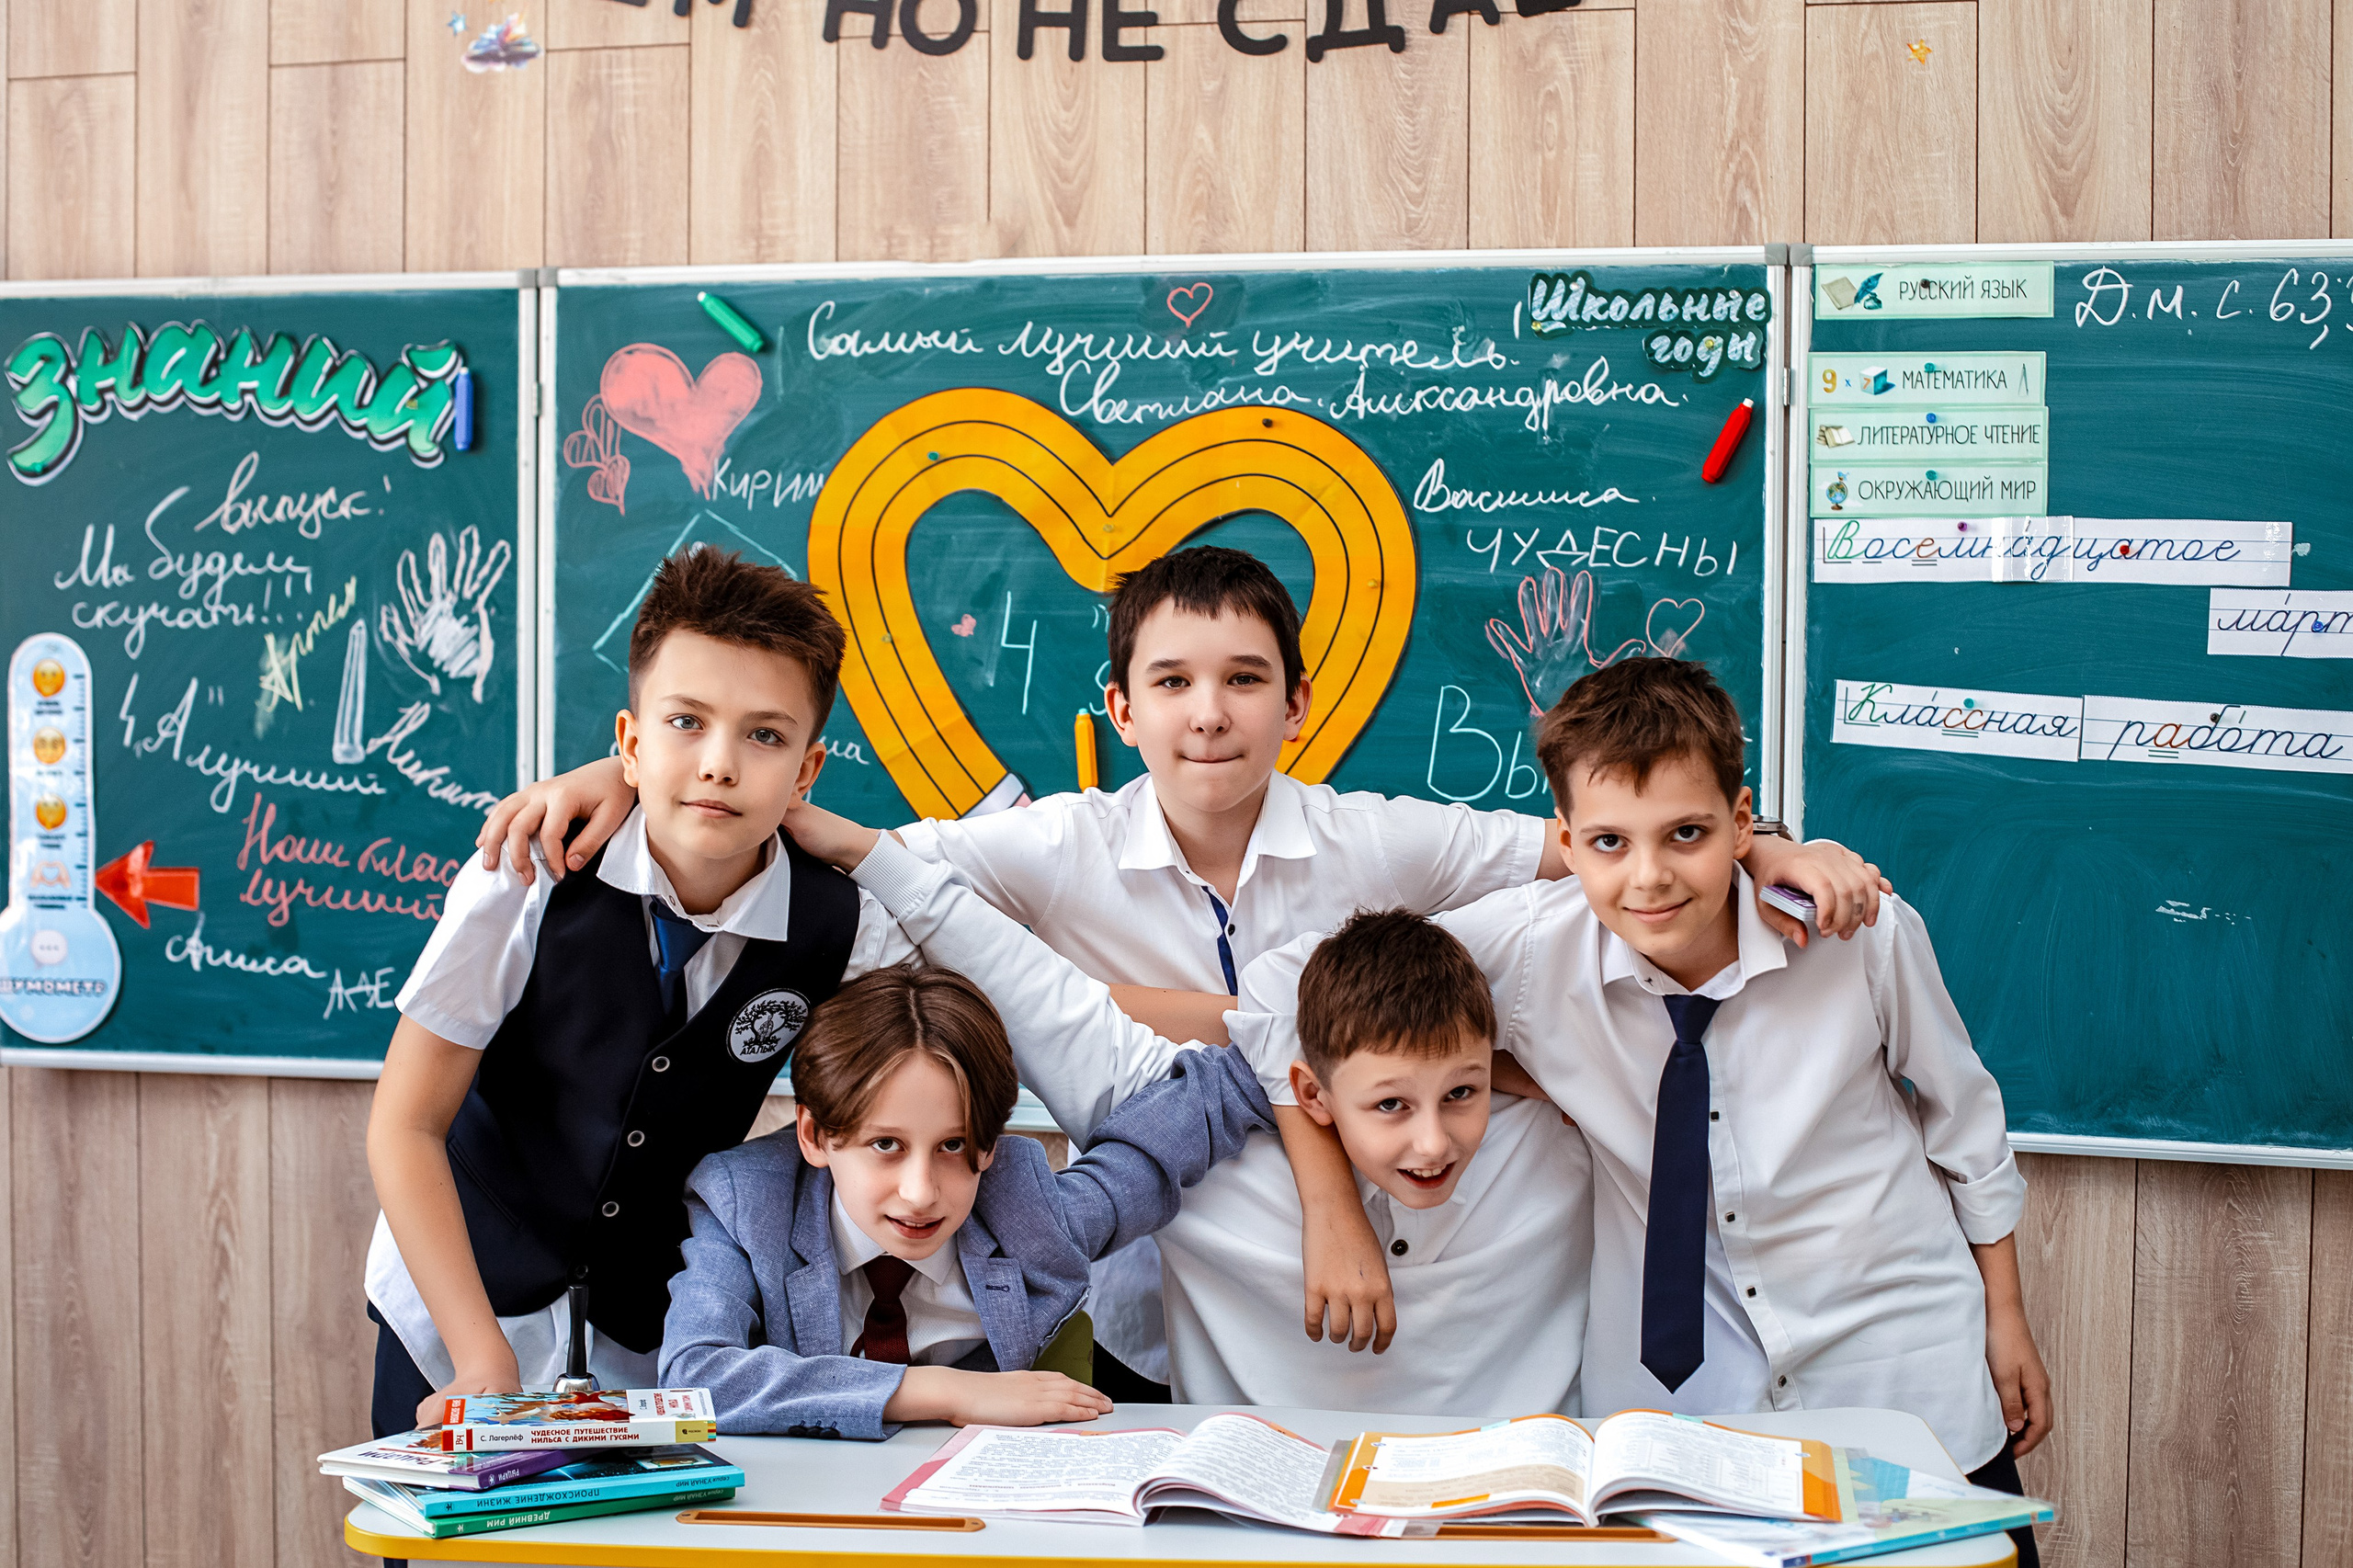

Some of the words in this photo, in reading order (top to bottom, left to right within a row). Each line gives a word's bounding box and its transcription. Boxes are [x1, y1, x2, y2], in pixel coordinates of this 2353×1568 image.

[1017, 0, 1165, 62] НЕ
[1899, 275, 1973, 301] РУССКИЙ
[1981, 278, 2028, 300] ЯЗЫК
[1530, 276, 1767, 325] Школьные
[807, 300, 983, 360] Самый
[1651, 332, 1756, 377] годы
[1902, 369, 2008, 390] МАТЕМАТИКА
[5, 319, 464, 484] знаний
[1857, 424, 1978, 446] ЛИТЕРАТУРНОЕ
[1984, 424, 2040, 445] ЧТЕНИЕ
[1858, 477, 1993, 503] ОКРУЖАЮЩИЙ
[2000, 480, 2036, 501] МИР
[1467, 526, 1737, 577] ЧУДЕСНЫ
[237, 792, 350, 870] Наш
[489, 1433, 524, 1442] Лагерлёф
[530, 1428, 571, 1437] ЧУДЕСНОЕ
[574, 1426, 629, 1435] ПУТЕШЕСТВИЕ
[572, 1435, 607, 1443] ДИКИМИ
[497, 1468, 520, 1482] РЫЦАРИ
[690, 1477, 712, 1487] УЗНАЙ
[476, 1497, 511, 1507] ЖИЗНИ
[515, 1489, 600, 1505] ПРОИСХОЖДЕНИЕ
[486, 1518, 506, 1528] РИМ
[508, 1511, 551, 1527] ДРЕВНИЙ
